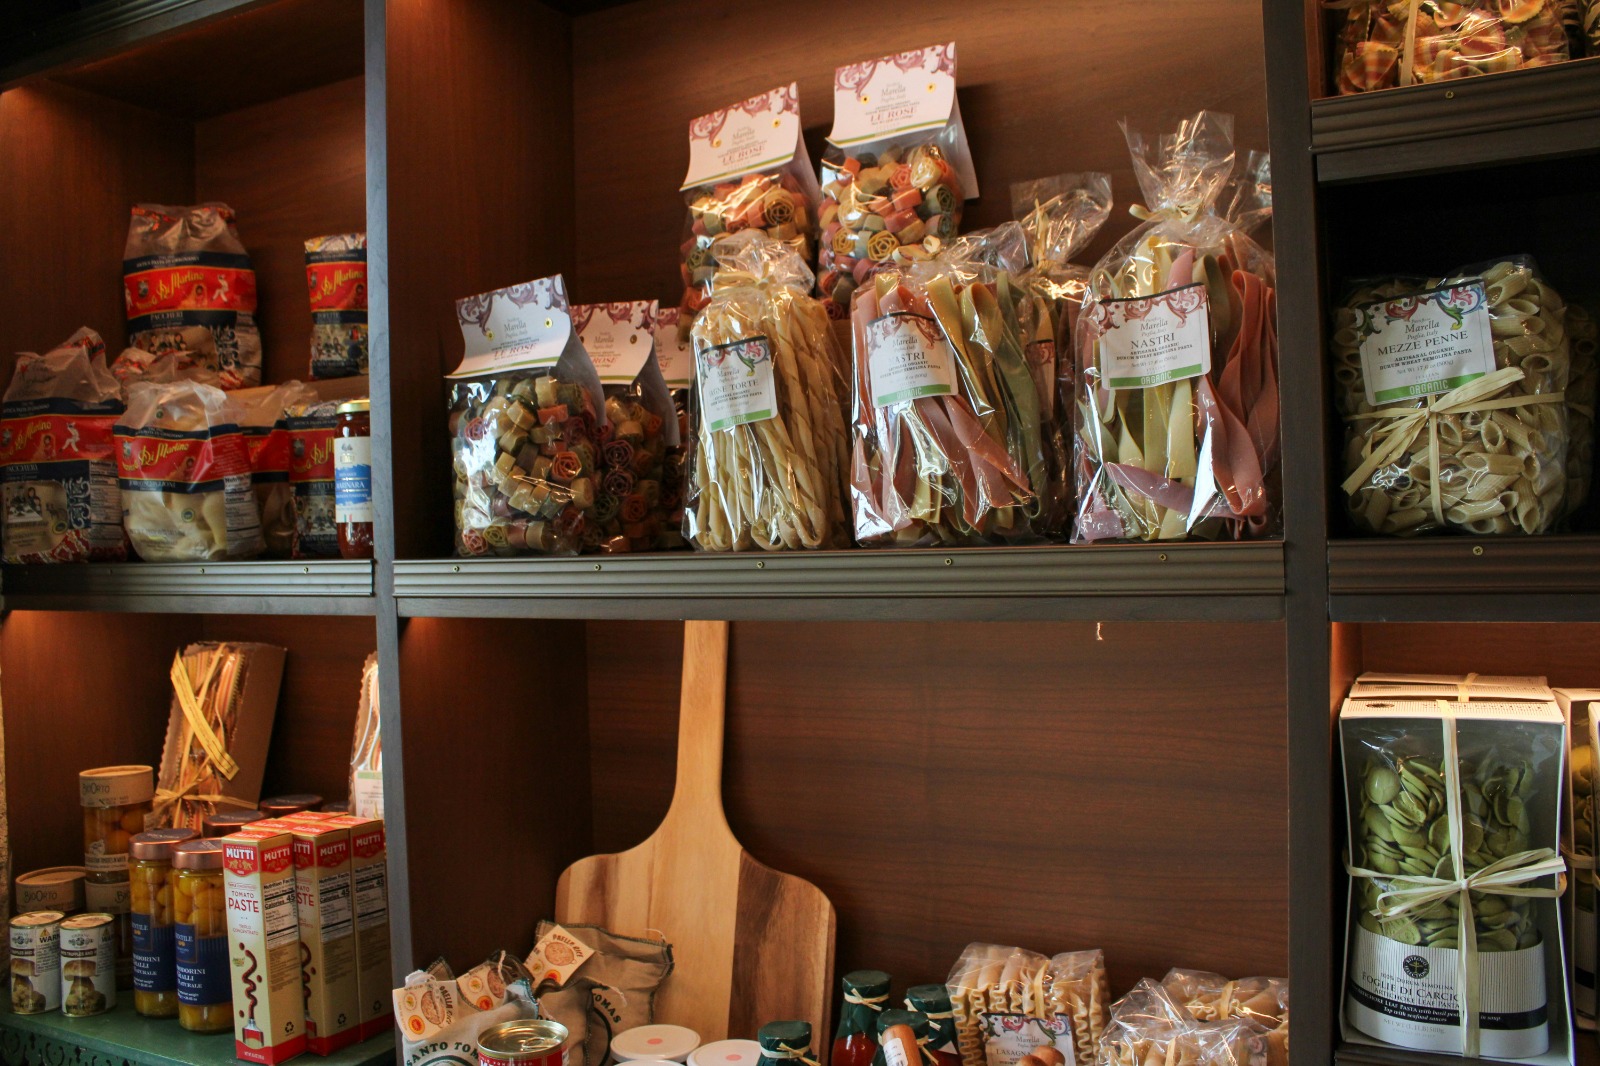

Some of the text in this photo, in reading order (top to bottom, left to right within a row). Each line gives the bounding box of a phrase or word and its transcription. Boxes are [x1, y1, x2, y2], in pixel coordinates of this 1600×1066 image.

[170, 272, 204, 297] Martino
[504, 322, 527, 332] Marella
[1140, 318, 1169, 331] Marella
[1405, 321, 1440, 334] Marella
[1131, 332, 1175, 350] NASTRI
[1377, 330, 1469, 356] MEZZE PENNE
[891, 352, 925, 364] ASTRI
[1379, 348, 1473, 370] DURUM WHEAT SEMOLINA PASTA
[1395, 346, 1455, 362] ARTISANAL ORGANIC
[730, 379, 759, 391] TORTE
[1141, 371, 1172, 385] ORGANIC
[1409, 379, 1449, 395] ORGANIC
[150, 442, 189, 465] Martino
[293, 842, 310, 854] TTI
[355, 834, 380, 848] MUTTI
[226, 847, 254, 860] MUTTI
[264, 847, 290, 862] MUTTI
[320, 842, 346, 857] MUTTI
[231, 890, 255, 899] TOMATO
[287, 893, 296, 902] 45
[296, 892, 314, 906] STE
[228, 897, 260, 913] PASTE
[40, 934, 60, 944] WARN
[1362, 971, 1397, 992] FOGLIE
[1399, 985, 1413, 996] DI
[1396, 976, 1420, 987] DURUM
[1421, 982, 1455, 992] SEMOLINA
[1374, 988, 1460, 1009] ARTICHOKE LEAF PASTA
[1383, 1006, 1392, 1014] Top
[1393, 1009, 1407, 1017] with
[1407, 1012, 1429, 1021] seafood
[1384, 999, 1399, 1008] LEAF
[1399, 1003, 1418, 1013] PASTA
[1446, 1010, 1460, 1018] pest
[1016, 1035, 1040, 1044] Marella
[406, 1041, 479, 1066] SANTO TOM
